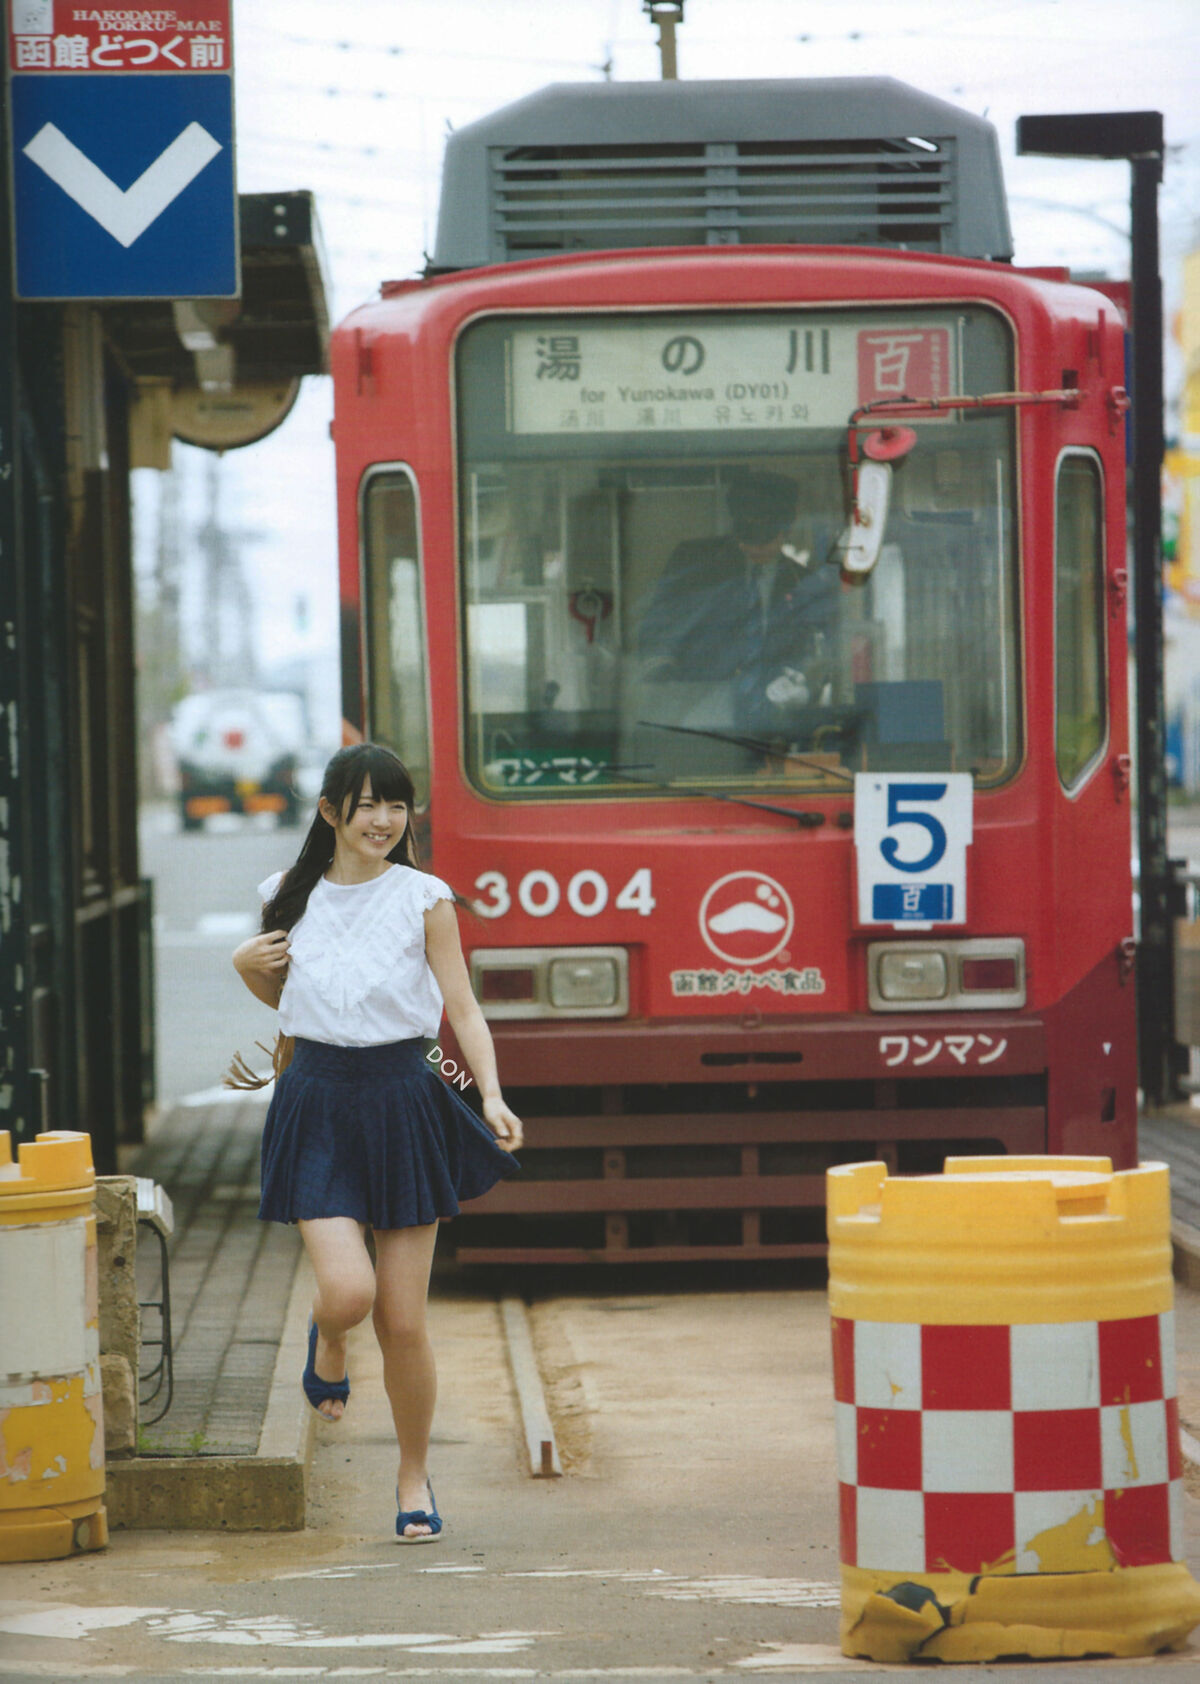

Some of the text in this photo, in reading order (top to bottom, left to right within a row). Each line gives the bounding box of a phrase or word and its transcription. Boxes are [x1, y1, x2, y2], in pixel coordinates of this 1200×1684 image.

[72, 10, 177, 21] HAKODATE
[98, 21, 223, 31] DOKKU-MAE
[15, 35, 225, 68] 函館どつく前
[536, 328, 830, 381] 湯の川
[866, 333, 924, 393] 百
[580, 381, 789, 403] for Yunokawa (DY01)
[879, 783, 948, 873] 5
[472, 867, 656, 919] 3004
[879, 1033, 1008, 1067] ワンマン
